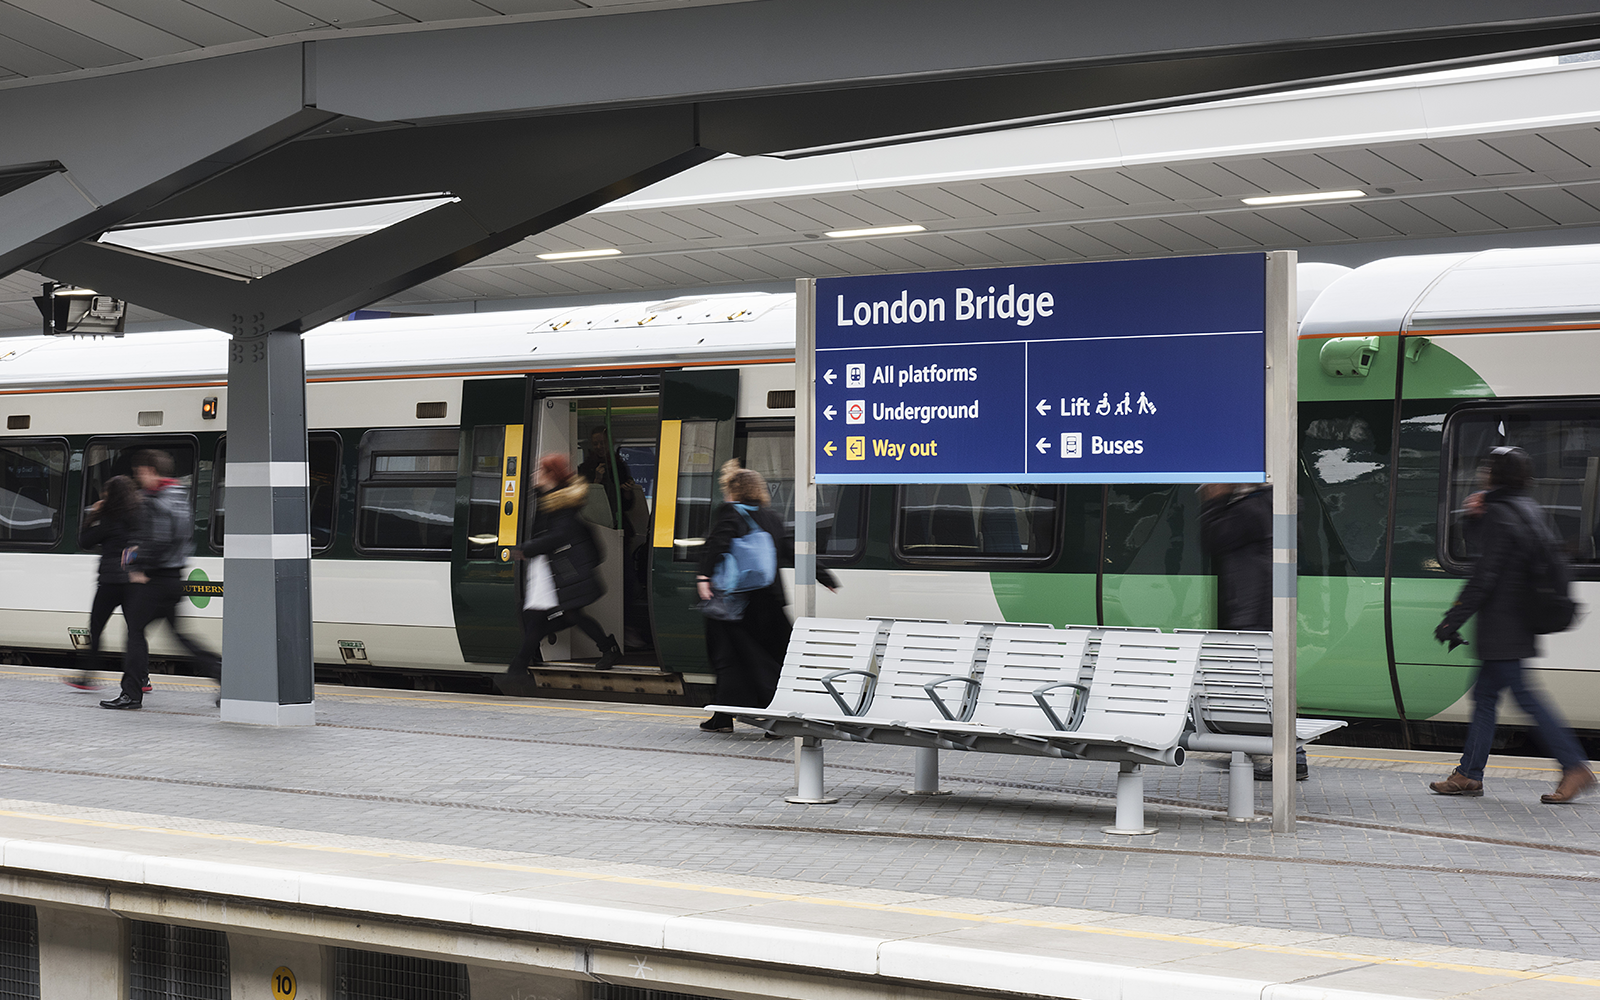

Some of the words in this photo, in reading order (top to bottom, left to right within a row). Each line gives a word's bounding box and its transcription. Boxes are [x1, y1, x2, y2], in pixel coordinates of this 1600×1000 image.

[837, 289, 946, 327] London
[955, 284, 1055, 327] Bridge
[872, 365, 894, 385] All
[898, 363, 978, 388] platforms
[872, 399, 980, 424] Underground
[1060, 397, 1091, 417] Lift
[872, 438, 906, 461] Way
[909, 439, 938, 457] out
[1091, 435, 1145, 455] Buses
[276, 974, 292, 995] 10
